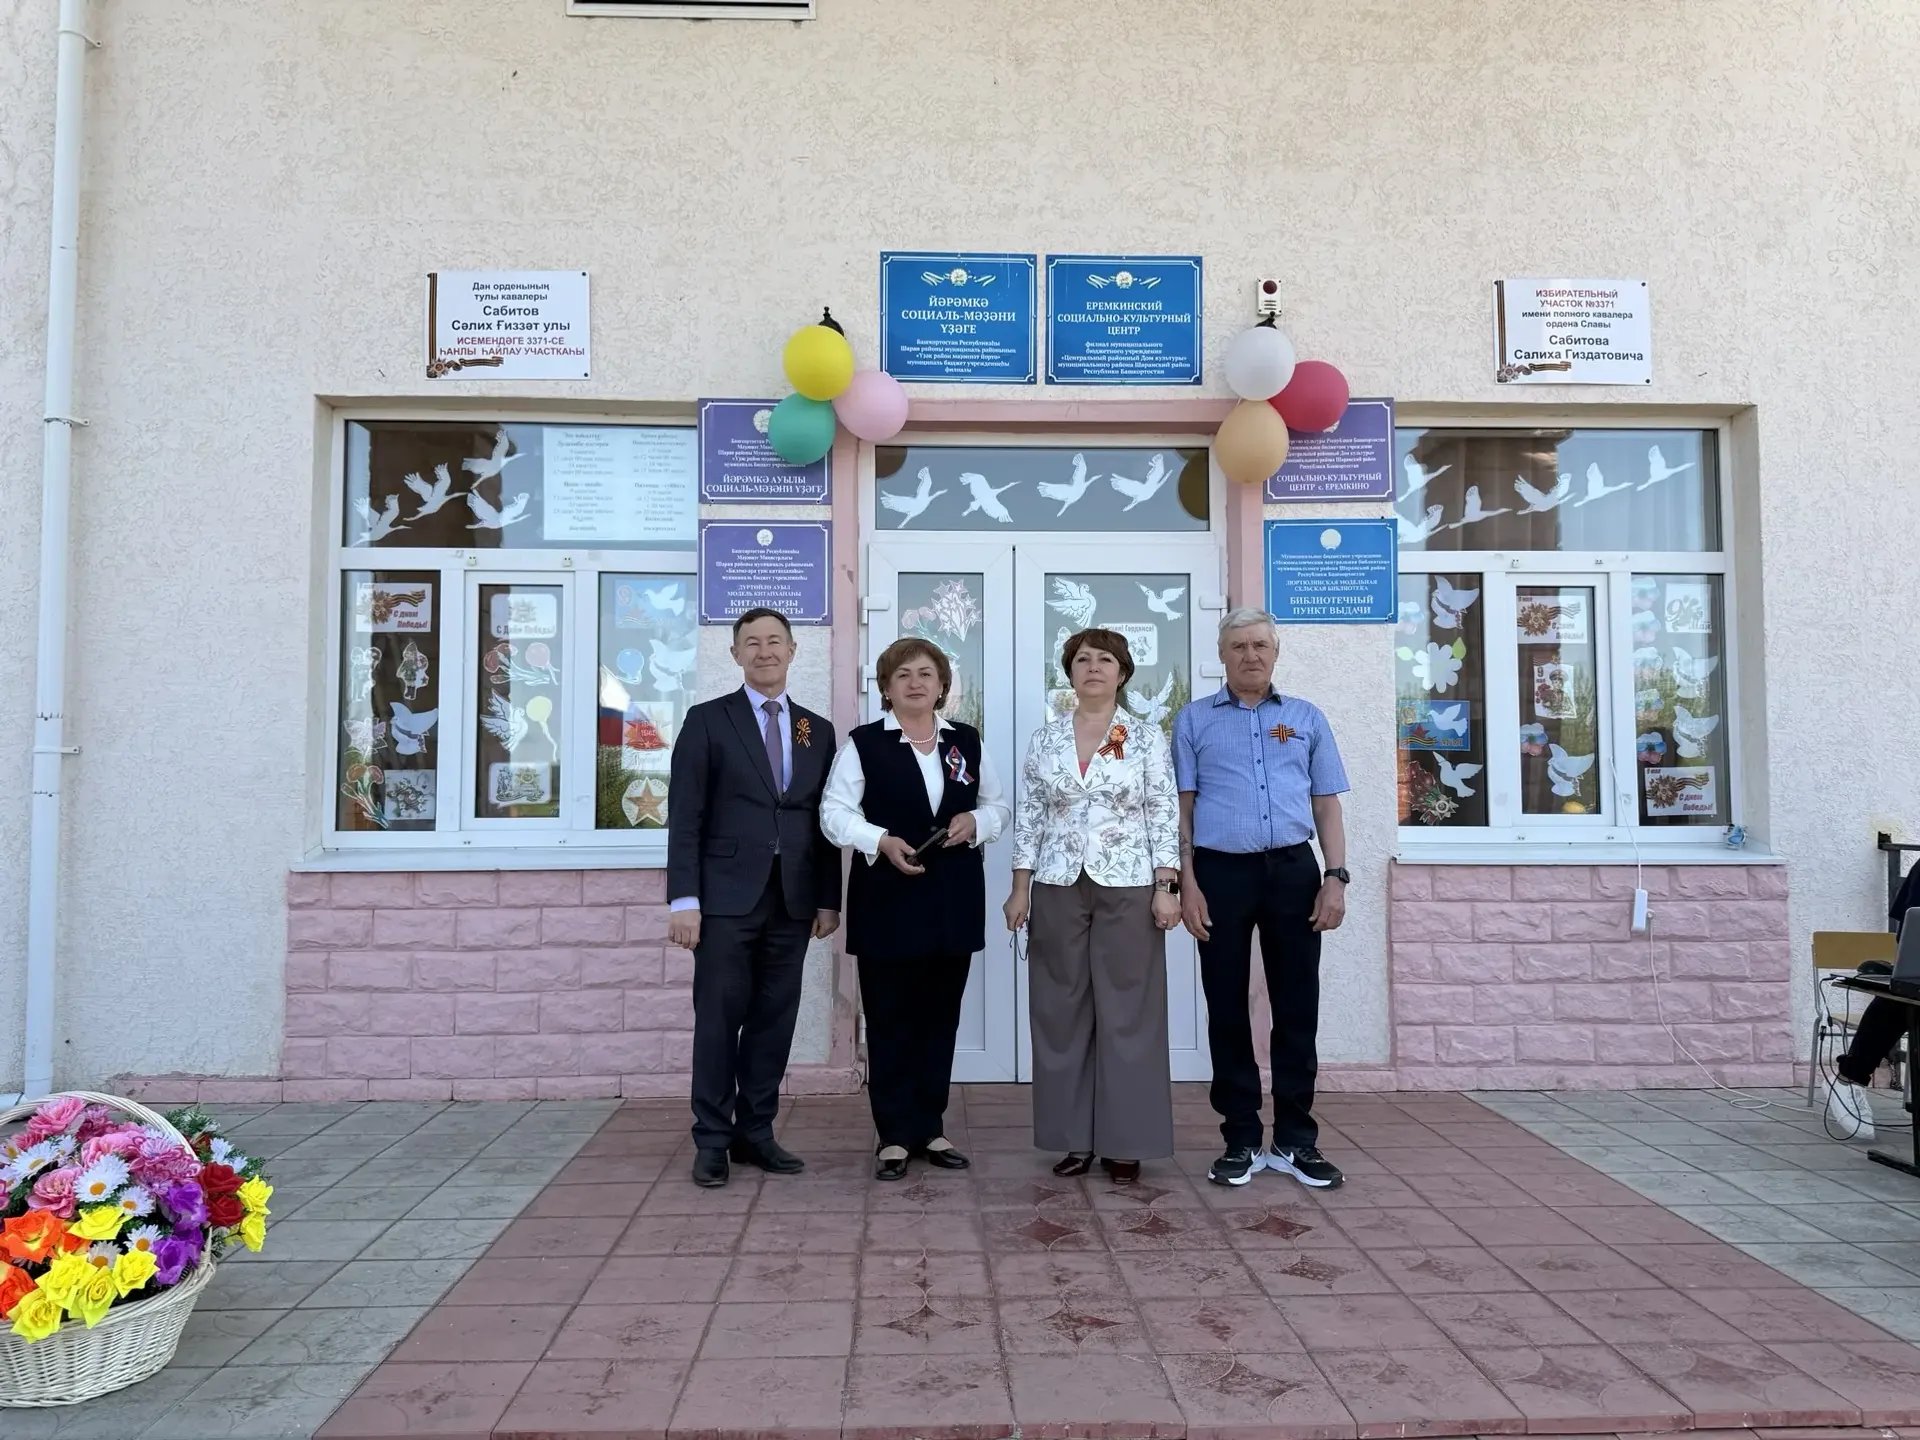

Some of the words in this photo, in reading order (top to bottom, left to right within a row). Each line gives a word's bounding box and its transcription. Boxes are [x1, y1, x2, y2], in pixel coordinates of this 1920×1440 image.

[473, 282, 490, 291] Дан
[493, 283, 550, 292] орденының
[474, 293, 498, 302] тулы
[502, 293, 548, 302] кавалеры
[1536, 288, 1618, 298] ИЗБИРАТЕЛЬНЫЙ
[929, 296, 988, 308] ЙӘРӘМКӘ
[1086, 301, 1162, 311] ЕРЕМКИНСКИЙ
[1540, 300, 1583, 308] УЧАСТОК
[1585, 300, 1614, 308] №3371
[483, 305, 539, 315] Сабитов
[902, 310, 1016, 322] СОЦИАЛЬ-МӘҘӘНИ
[1058, 312, 1191, 323] СОЦИАЛЬНО-КУЛЬТУРНЫЙ
[1593, 311, 1633, 320] кавалера
[452, 320, 492, 330] Сәлих
[497, 320, 540, 330] Ғиззәт
[543, 322, 570, 332] улы
[940, 324, 976, 335] ҮҘӘГЕ
[1546, 320, 1578, 329] ордена
[1581, 320, 1611, 328] Славы
[1108, 326, 1140, 336] ЦЕНТР
[457, 337, 524, 346] ИСЕМЕНДӘГЕ
[527, 337, 564, 345] 3371-СЕ
[1549, 335, 1609, 345] Сабитова
[1514, 350, 1562, 359] Салиха
[1565, 350, 1643, 361] Гиздатовича
[723, 474, 769, 483] ЙӘРӘМКӘ
[771, 476, 806, 484] АУЫЛЫ
[1277, 473, 1381, 482] СОЦИАЛЬНО-КУЛЬТУРНЫЙ
[1290, 483, 1315, 491] ЦЕНТР
[1325, 483, 1369, 491] ЕРЕМКИНО
[1290, 595, 1374, 604] БИБЛИОТЕЧНЫЙ
[1293, 607, 1327, 615] ПУНКТ
[1330, 606, 1371, 615] ВЫДАЧИ
[1537, 667, 1543, 678] 9
